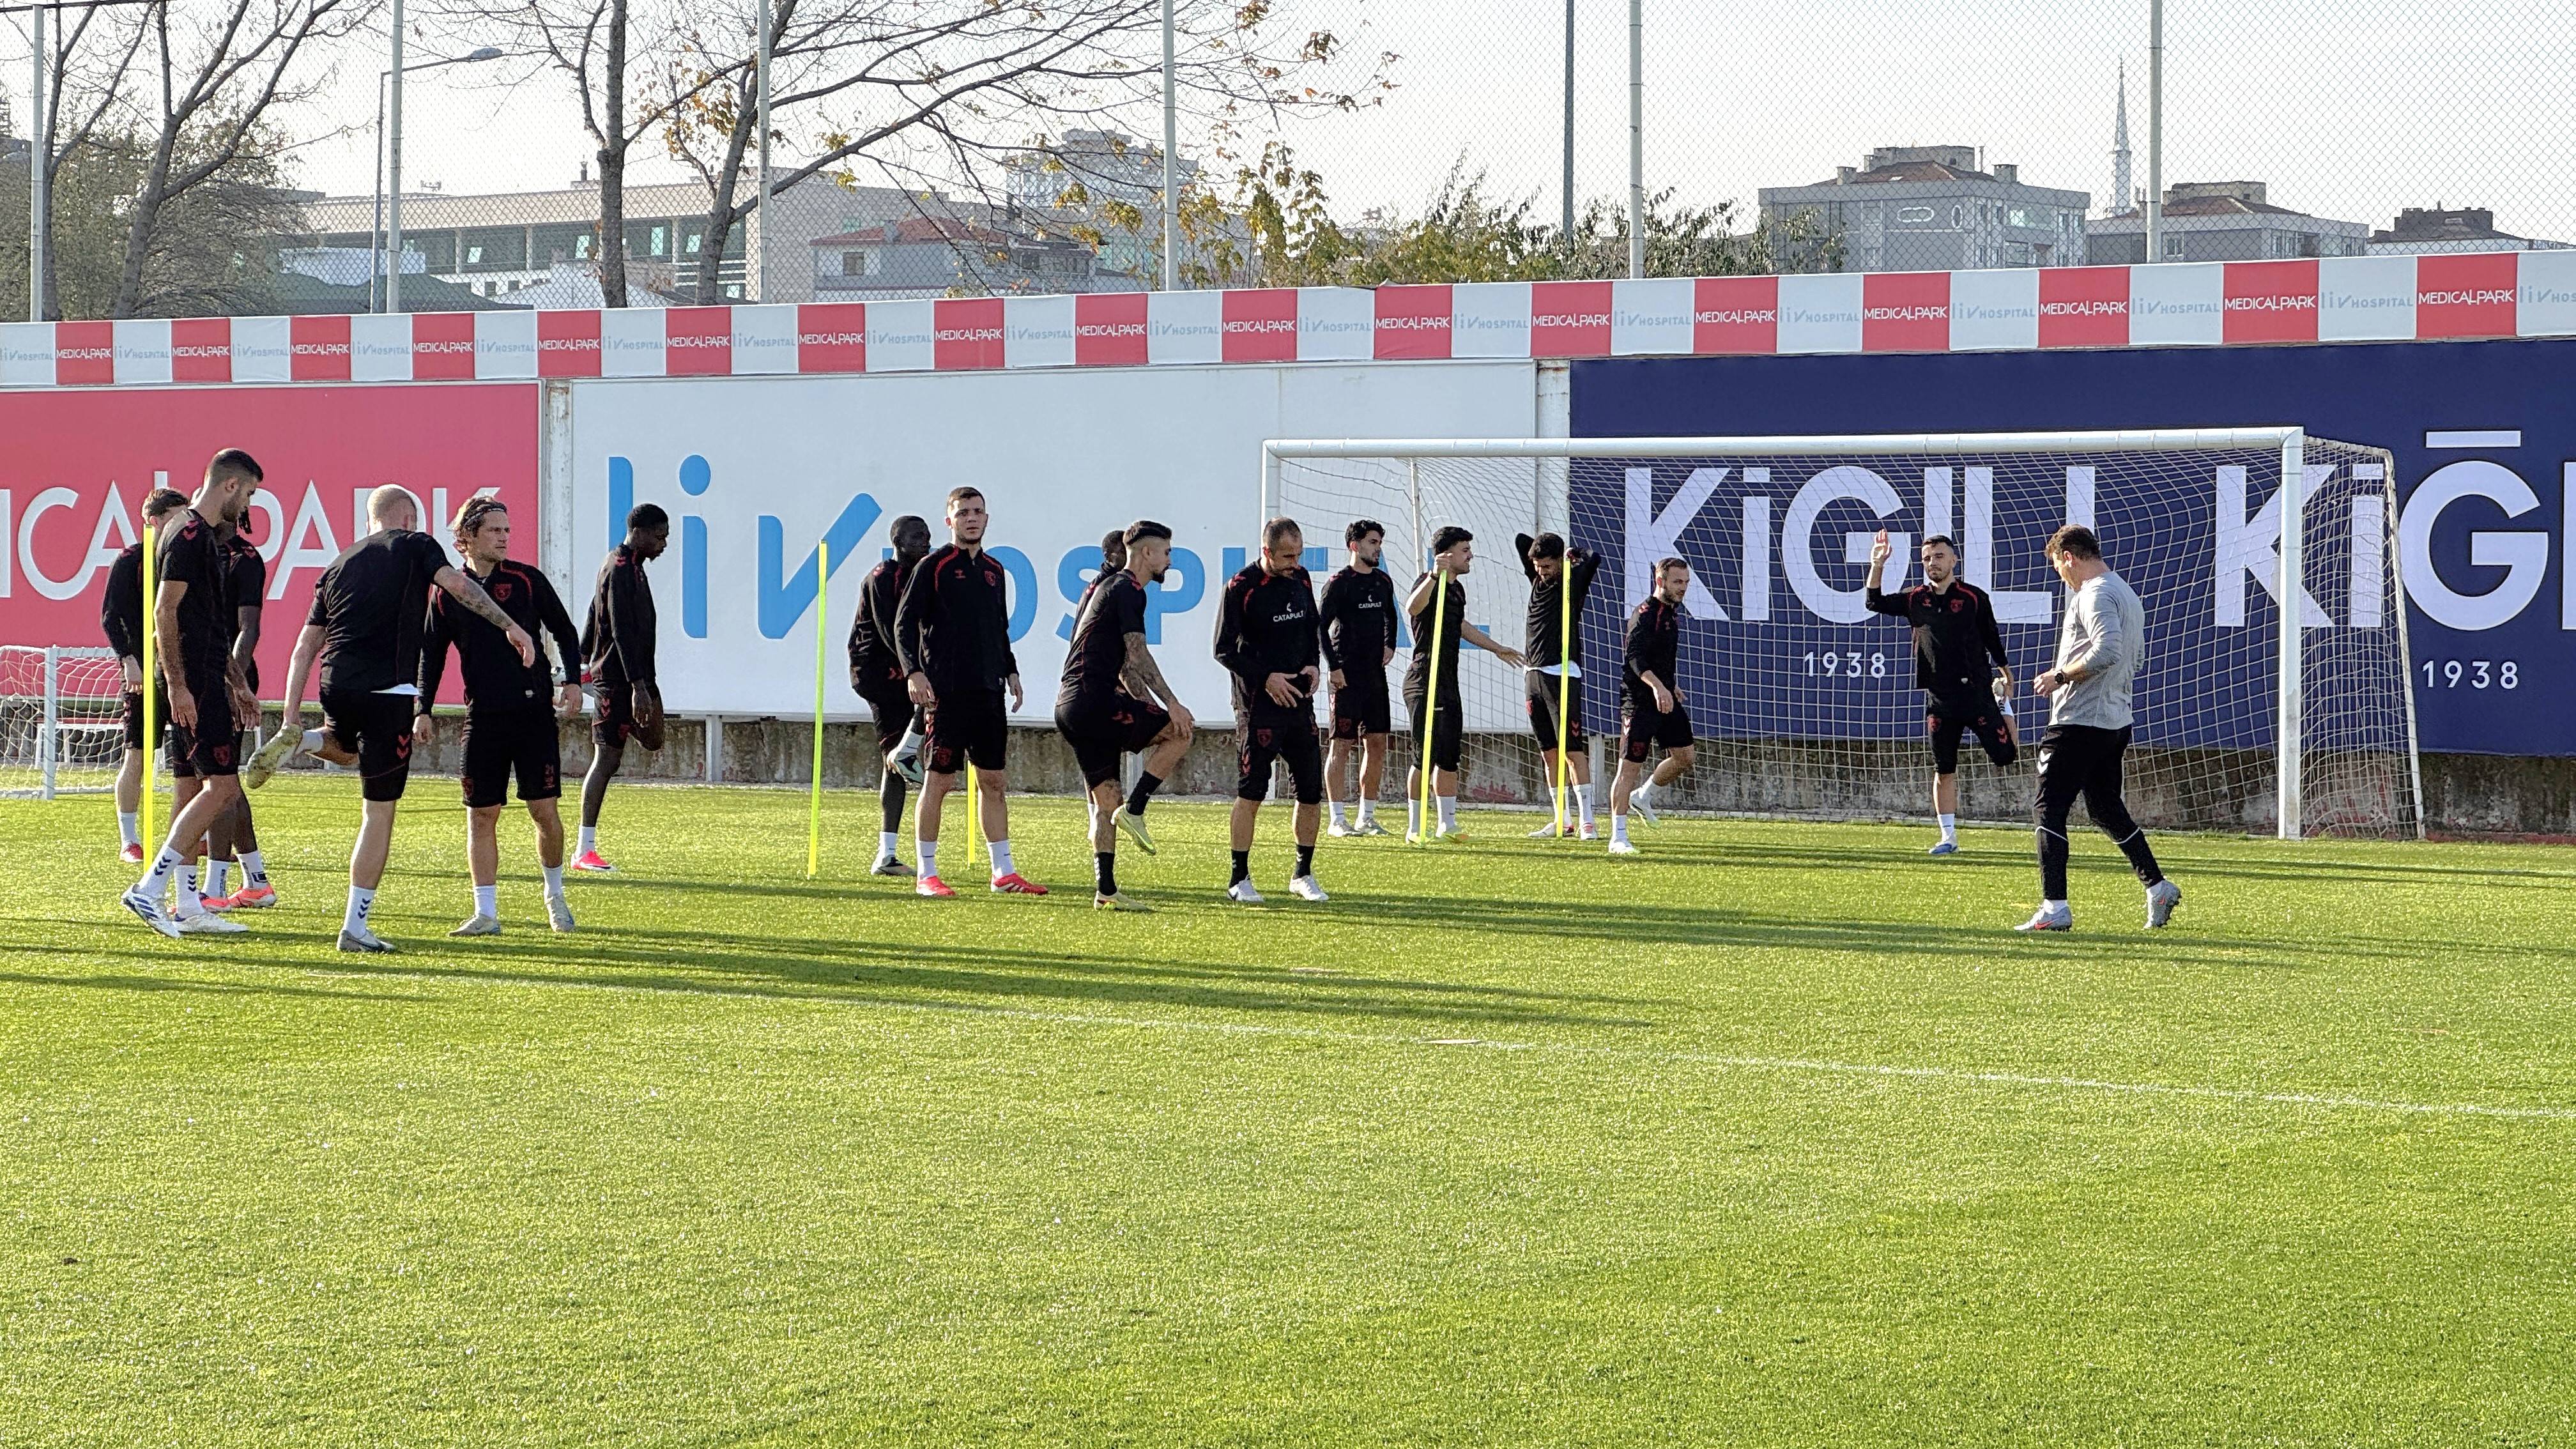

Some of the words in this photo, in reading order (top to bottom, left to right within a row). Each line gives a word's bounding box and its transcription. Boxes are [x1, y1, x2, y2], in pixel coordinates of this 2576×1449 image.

[2352, 298, 2413, 308] HOSPITAL
[2161, 304, 2219, 314] HOSPITAL
[1806, 314, 1859, 323] HOSPITAL
[1980, 309, 2035, 319] HOSPITAL
[1478, 320, 1528, 329] HOSPITAL
[1639, 317, 1690, 326] HOSPITAL
[1172, 326, 1218, 335] HOSPITAL
[1323, 323, 1370, 332] HOSPITAL
[888, 335, 931, 344] HOSPITAL
[1028, 331, 1072, 339] HOSPITAL
[623, 342, 663, 350] HOSPITAL
[753, 339, 795, 347] HOSPITAL
[496, 344, 535, 353] HOSPITAL
[1273, 610, 1304, 622] CATAPULT
[1804, 652, 1886, 678] 1938
[2423, 660, 2519, 691] 1938
